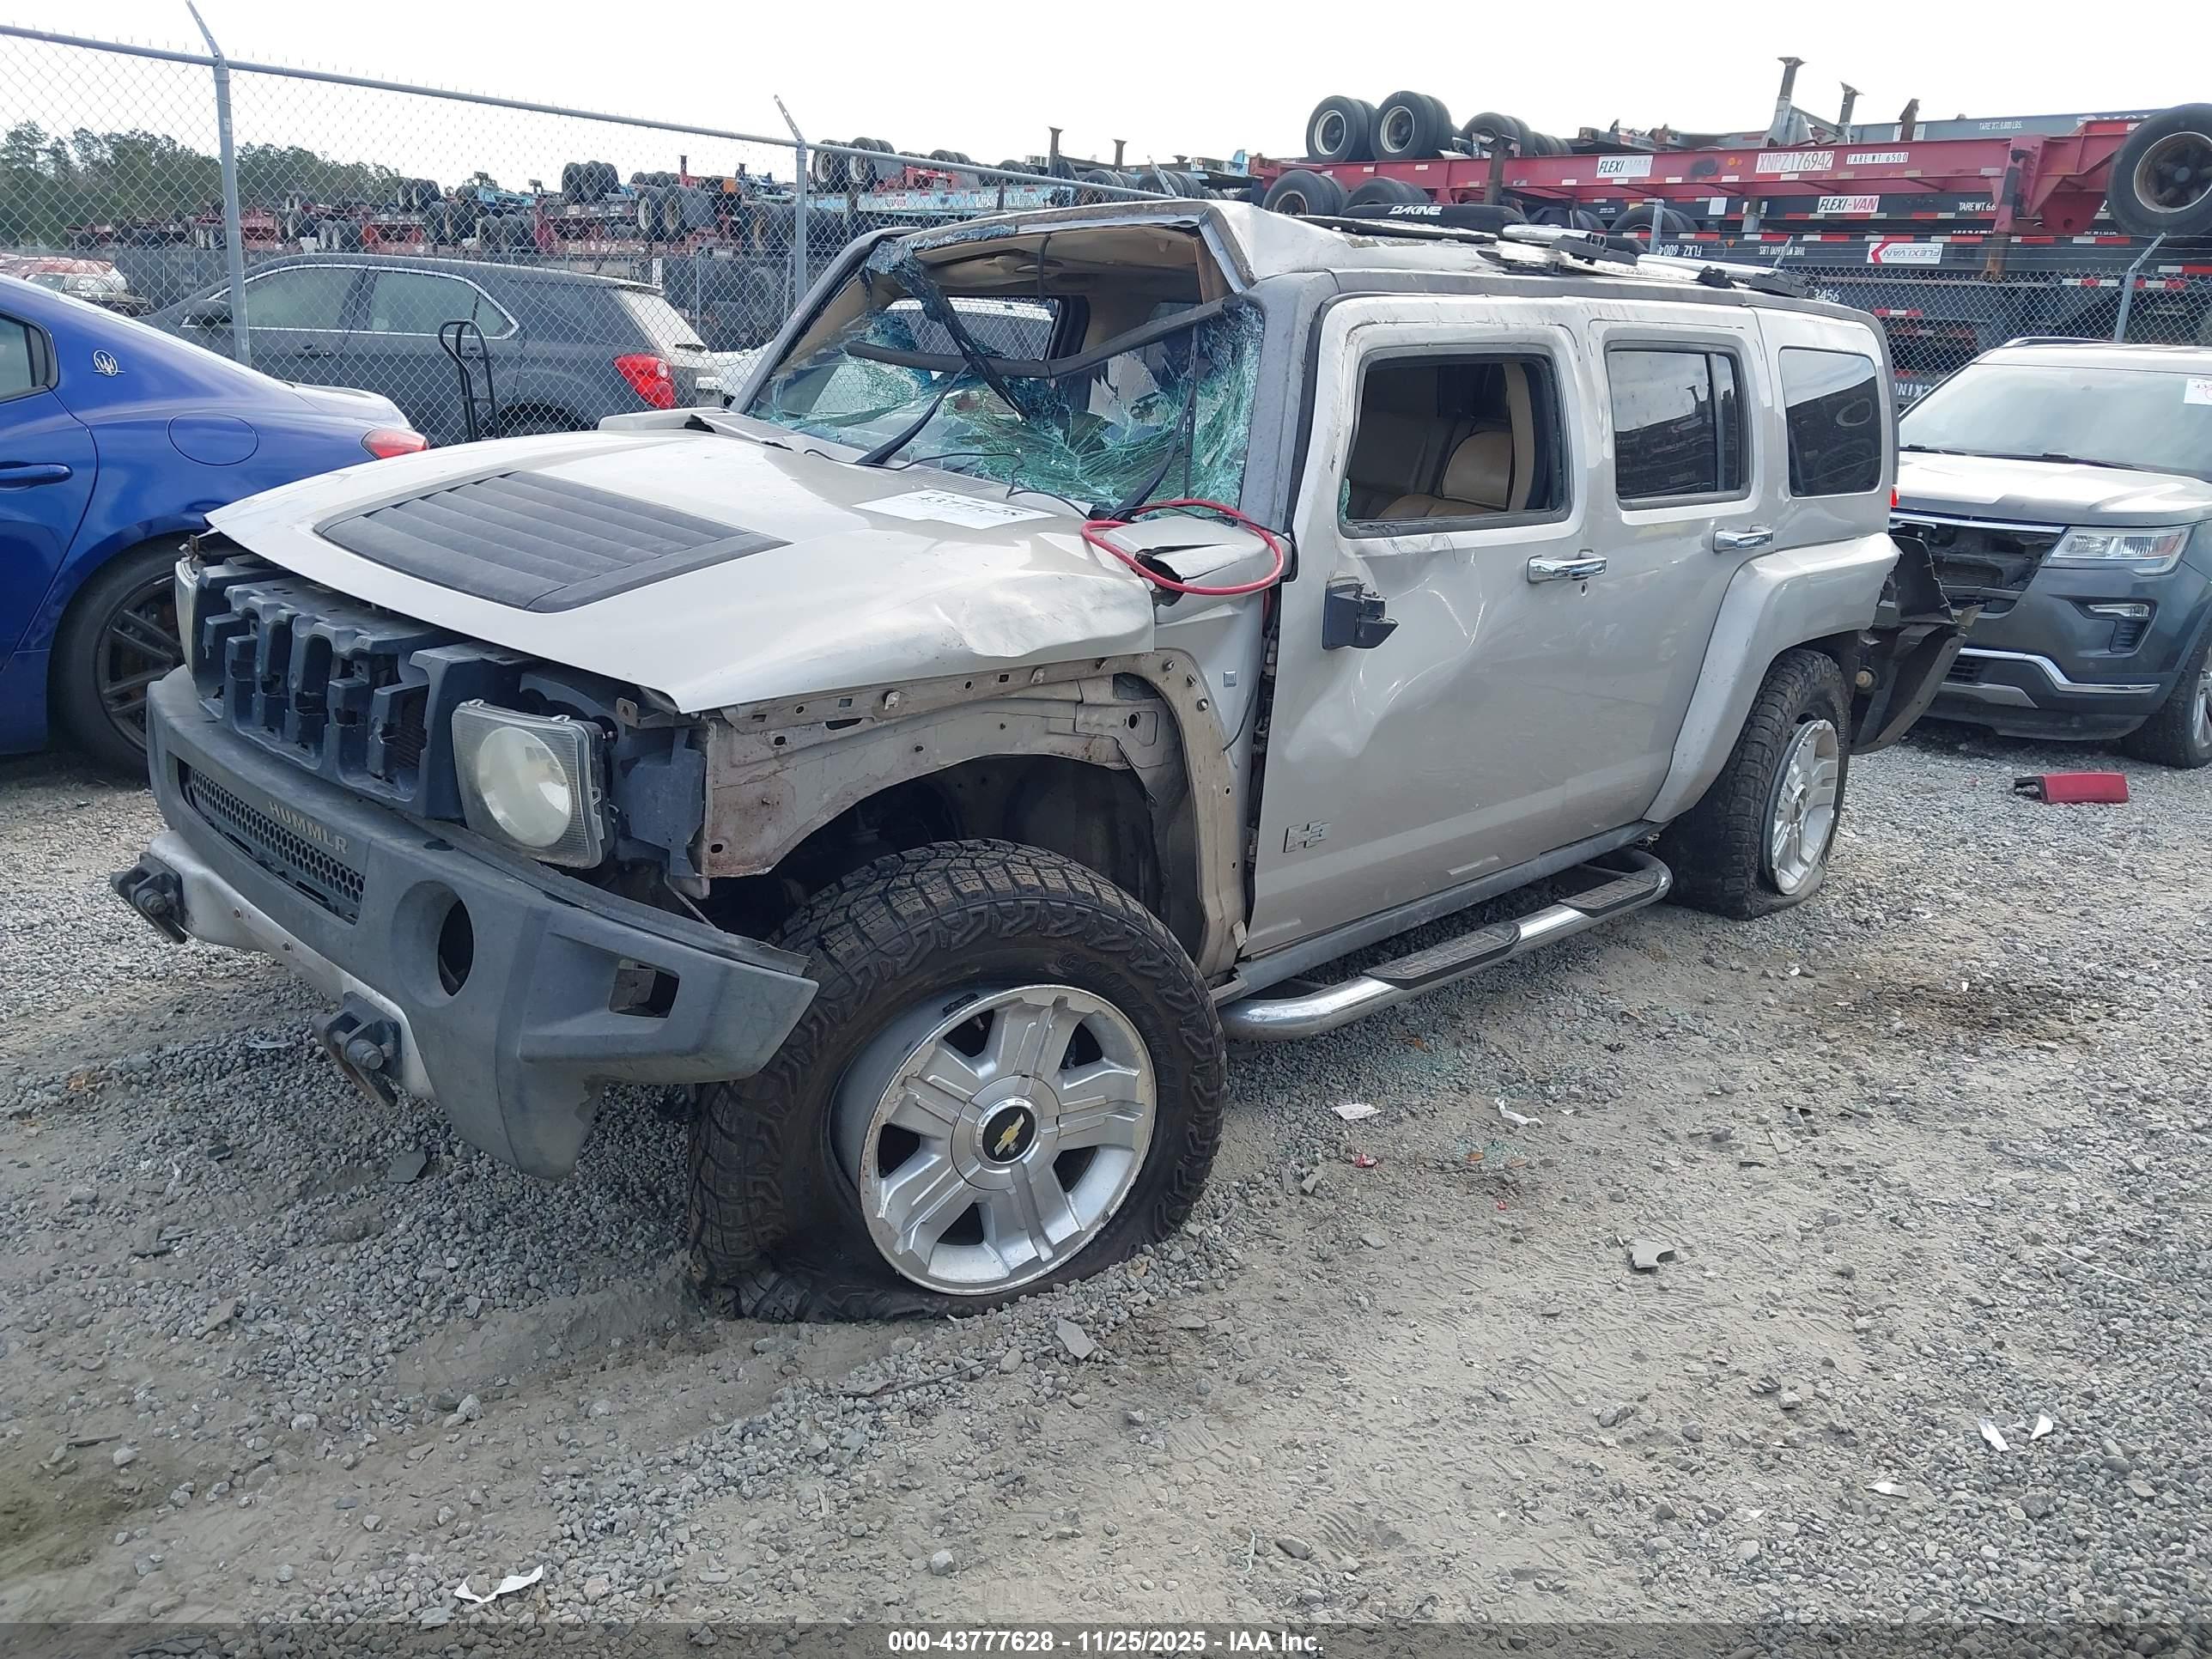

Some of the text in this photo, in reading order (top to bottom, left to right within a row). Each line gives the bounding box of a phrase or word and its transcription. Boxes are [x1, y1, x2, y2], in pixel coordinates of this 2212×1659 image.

[1757, 152, 1833, 172] XNPZ176942
[1848, 155, 1869, 163] TARE
[1886, 153, 1908, 162] 6500
[1598, 159, 1625, 173] FLEXI
[1819, 198, 1877, 211] FLEXI-VAN
[1959, 202, 1975, 211] TARE
[1388, 205, 1443, 216] DAKINE
[1656, 245, 1679, 256] 6004
